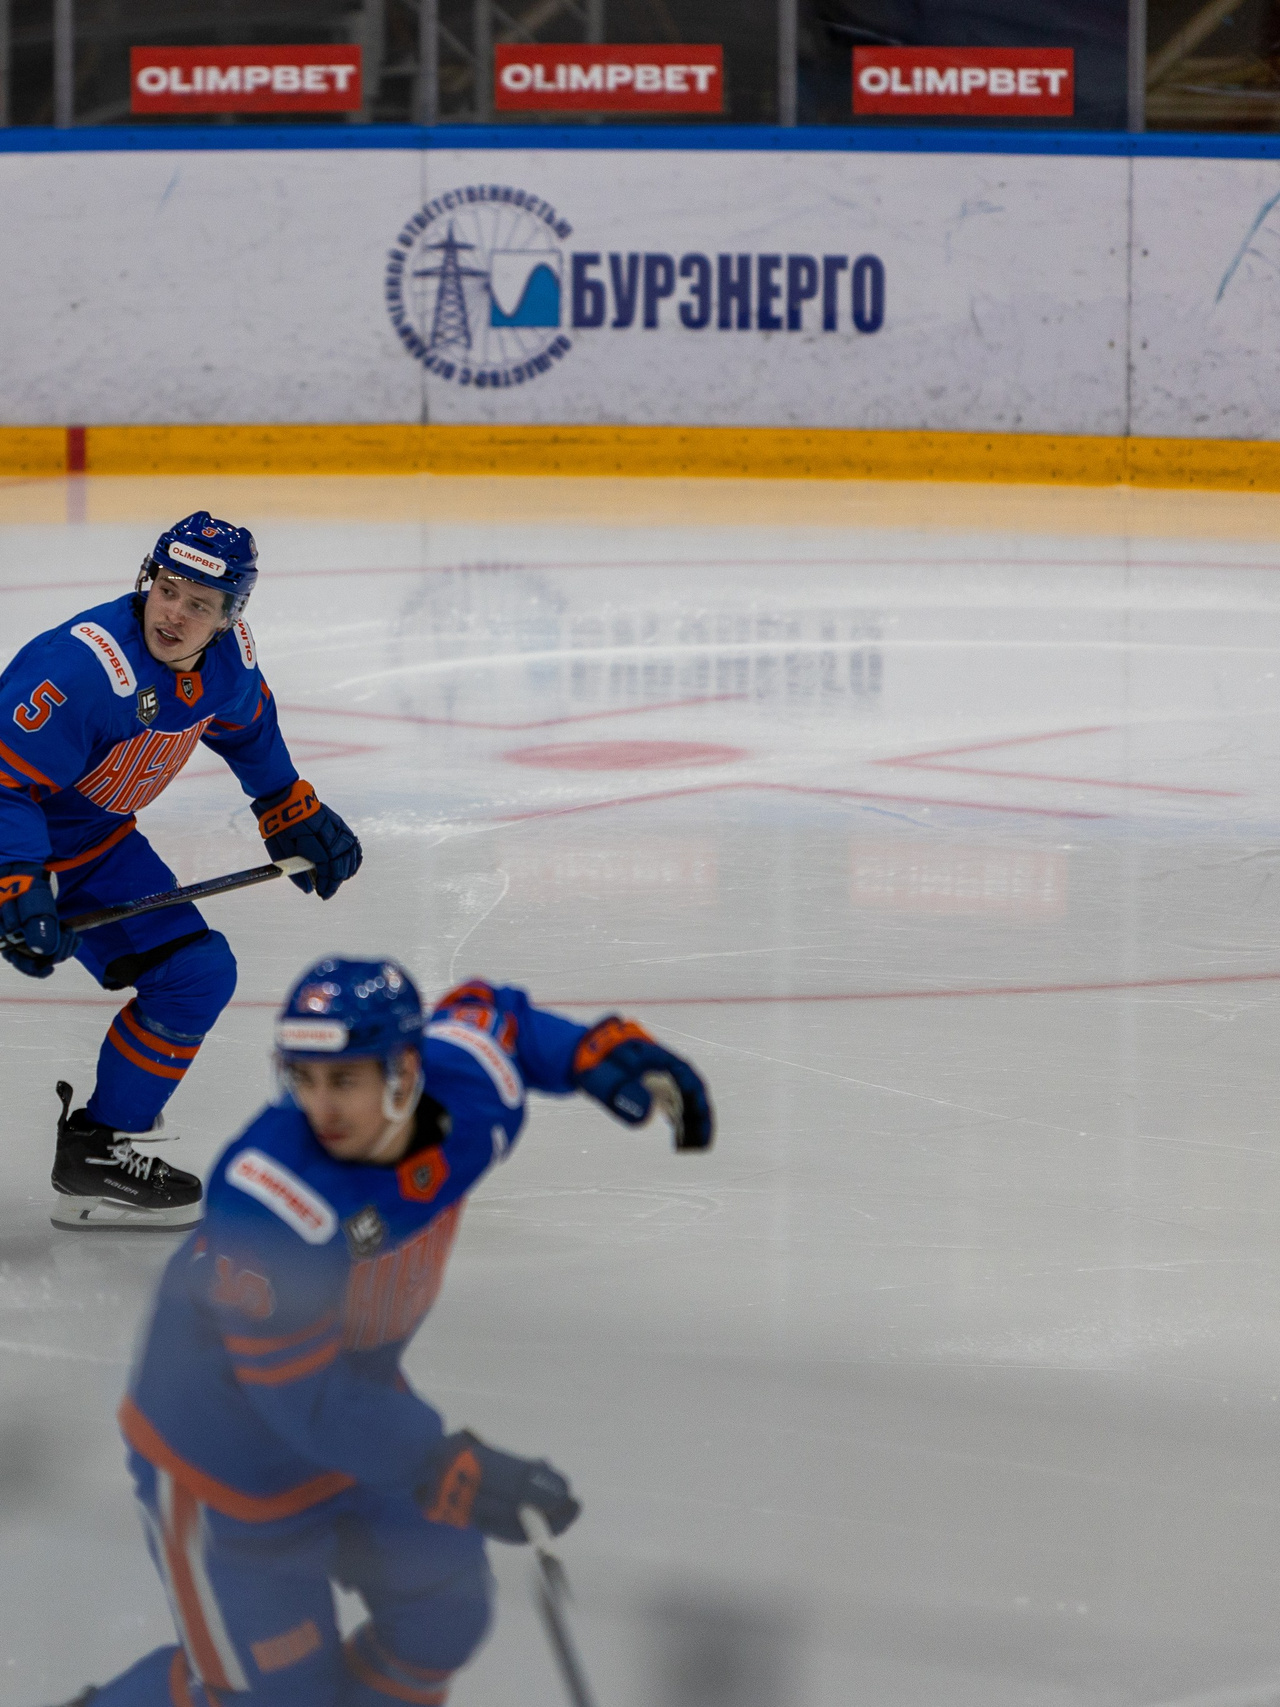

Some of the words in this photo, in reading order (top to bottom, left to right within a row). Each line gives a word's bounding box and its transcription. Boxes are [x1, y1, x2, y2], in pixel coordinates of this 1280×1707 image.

[137, 64, 357, 96] OLIMPBET
[501, 63, 716, 94] OLIMPBET
[858, 66, 1068, 97] OLIMPBET
[571, 251, 886, 333] БУРЭНЕРГО
[172, 547, 222, 571] OLIMPBET
[79, 626, 130, 687] OLIMPBET
[13, 678, 68, 733] 5
[263, 788, 319, 835] CCM
[103, 1178, 139, 1196] BAUER
